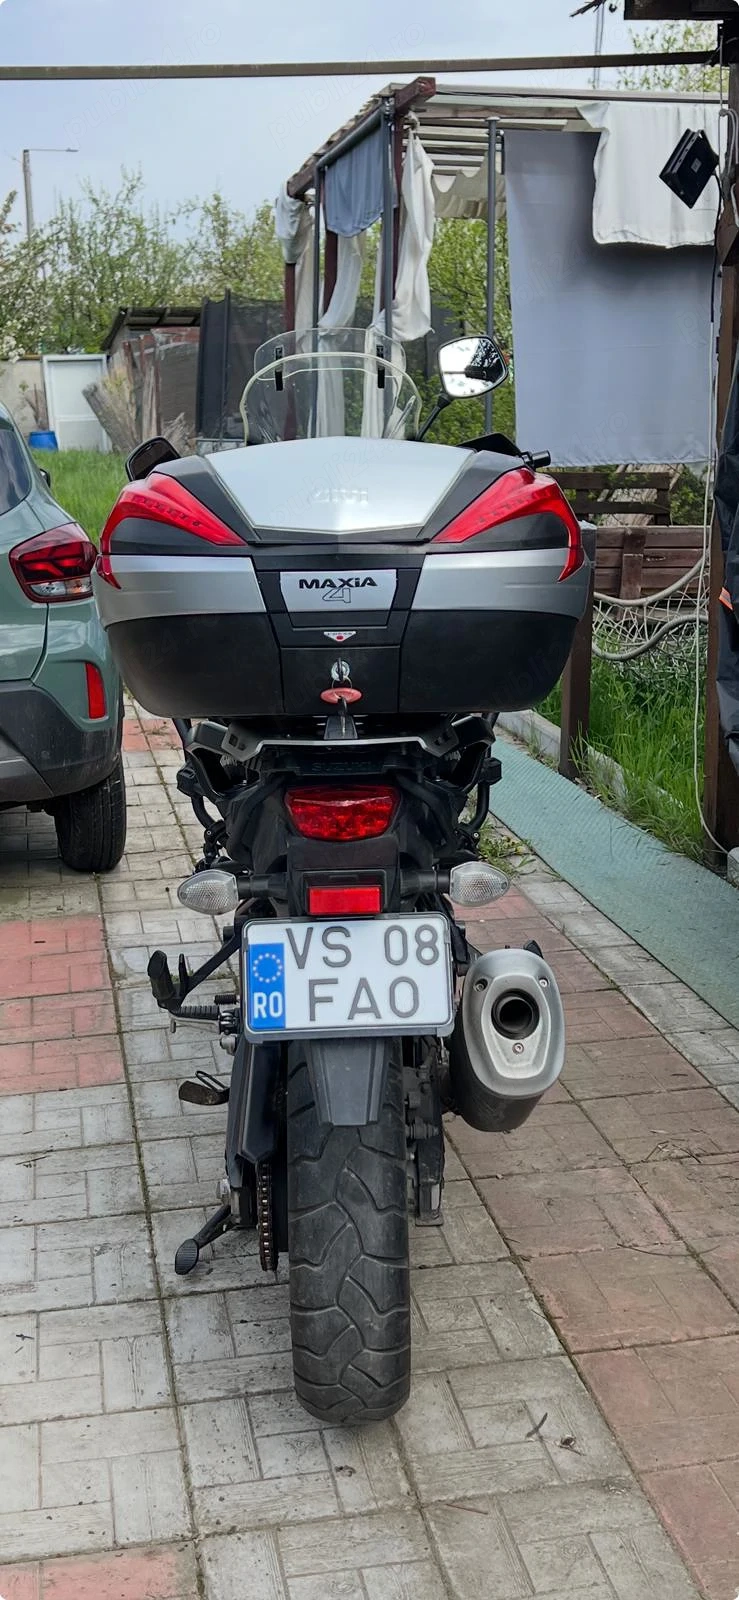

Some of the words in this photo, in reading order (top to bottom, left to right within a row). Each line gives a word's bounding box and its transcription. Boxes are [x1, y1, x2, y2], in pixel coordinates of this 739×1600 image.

[322, 588, 352, 603] 4
[286, 926, 351, 969] VS
[384, 924, 440, 966] 08
[253, 992, 283, 1019] RO
[309, 976, 420, 1022] FAO
